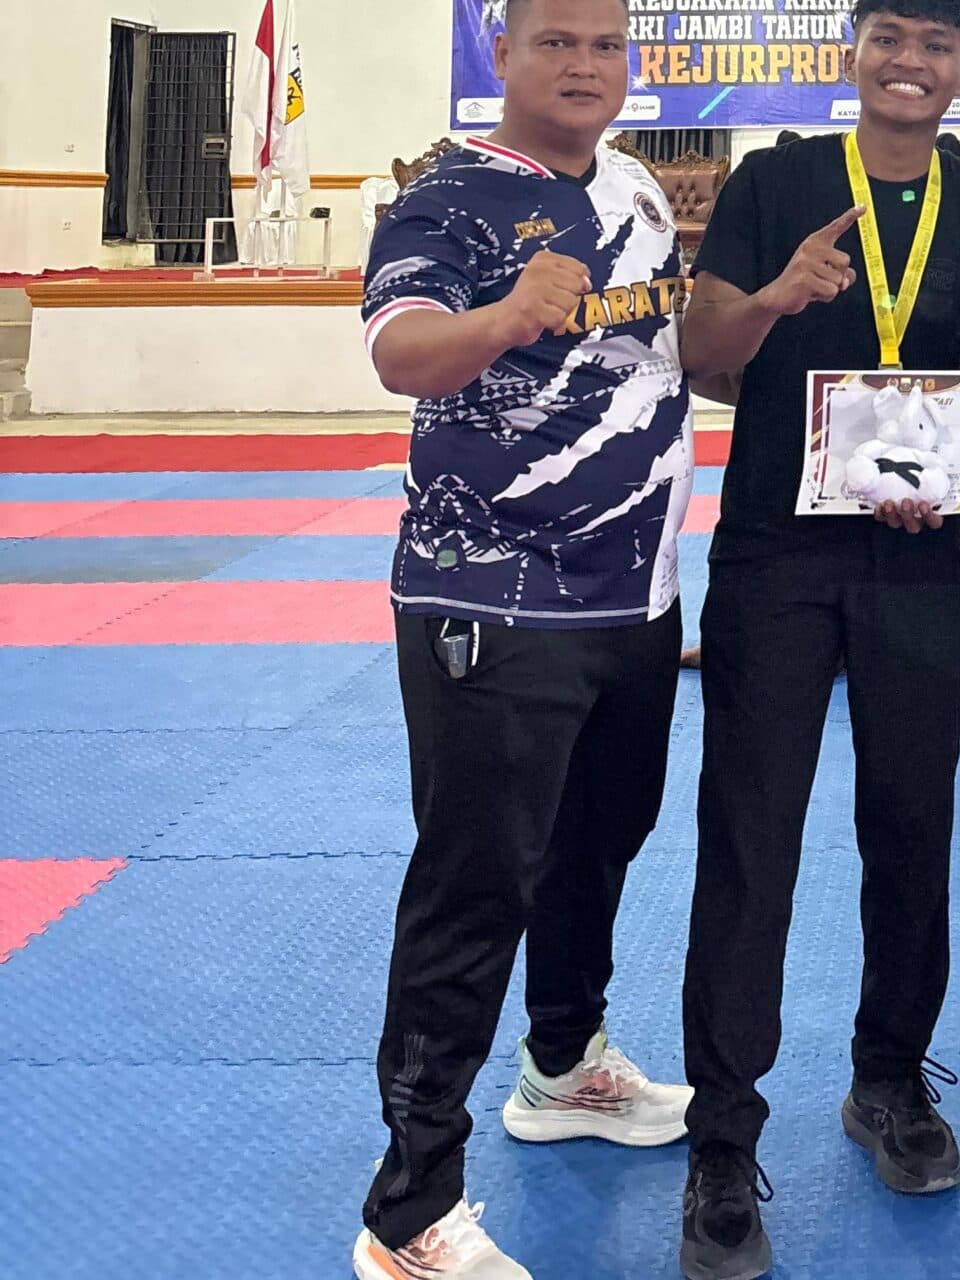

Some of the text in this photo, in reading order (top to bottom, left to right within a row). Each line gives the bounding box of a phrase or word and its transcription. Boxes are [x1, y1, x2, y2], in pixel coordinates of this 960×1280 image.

[627, 15, 843, 41] RKI JAMBI TAHUN
[639, 44, 853, 84] KEJURPRO
